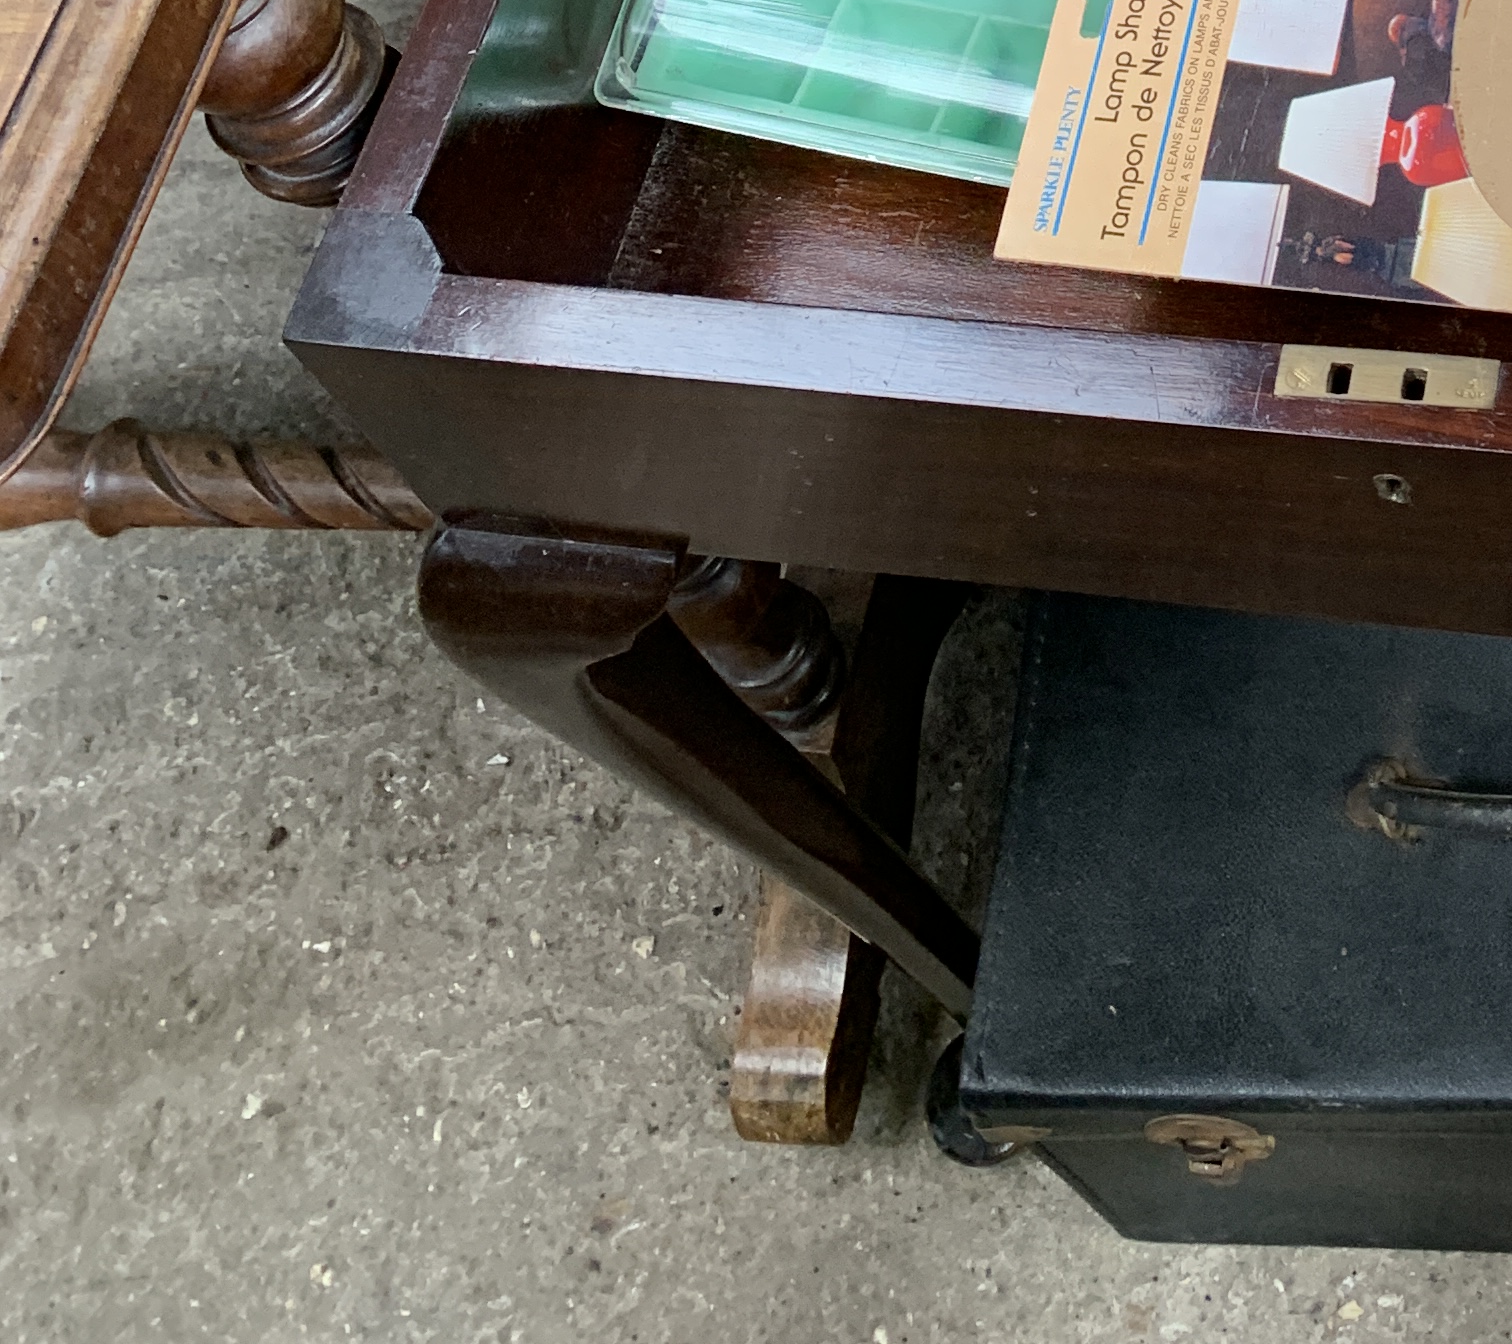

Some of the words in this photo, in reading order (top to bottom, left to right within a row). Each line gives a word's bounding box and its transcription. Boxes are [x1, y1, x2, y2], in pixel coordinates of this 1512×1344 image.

[1192, 14, 1211, 55] LAMPS
[1095, 50, 1137, 123] Lamp
[1187, 57, 1200, 75] ON
[1176, 79, 1196, 129] FABRICS
[1195, 69, 1213, 114] TISSUS
[1189, 118, 1203, 142] LES
[1034, 156, 1065, 233] SPARKLE
[1053, 86, 1082, 152] PLENTY
[1101, 133, 1148, 241] Tampon
[1131, 88, 1158, 122] de
[1163, 133, 1183, 183] CLEANS
[1181, 174, 1192, 182] A
[1184, 145, 1197, 170] SEC
[1157, 185, 1172, 212] DRY
[1168, 185, 1189, 239] NETTOIE
